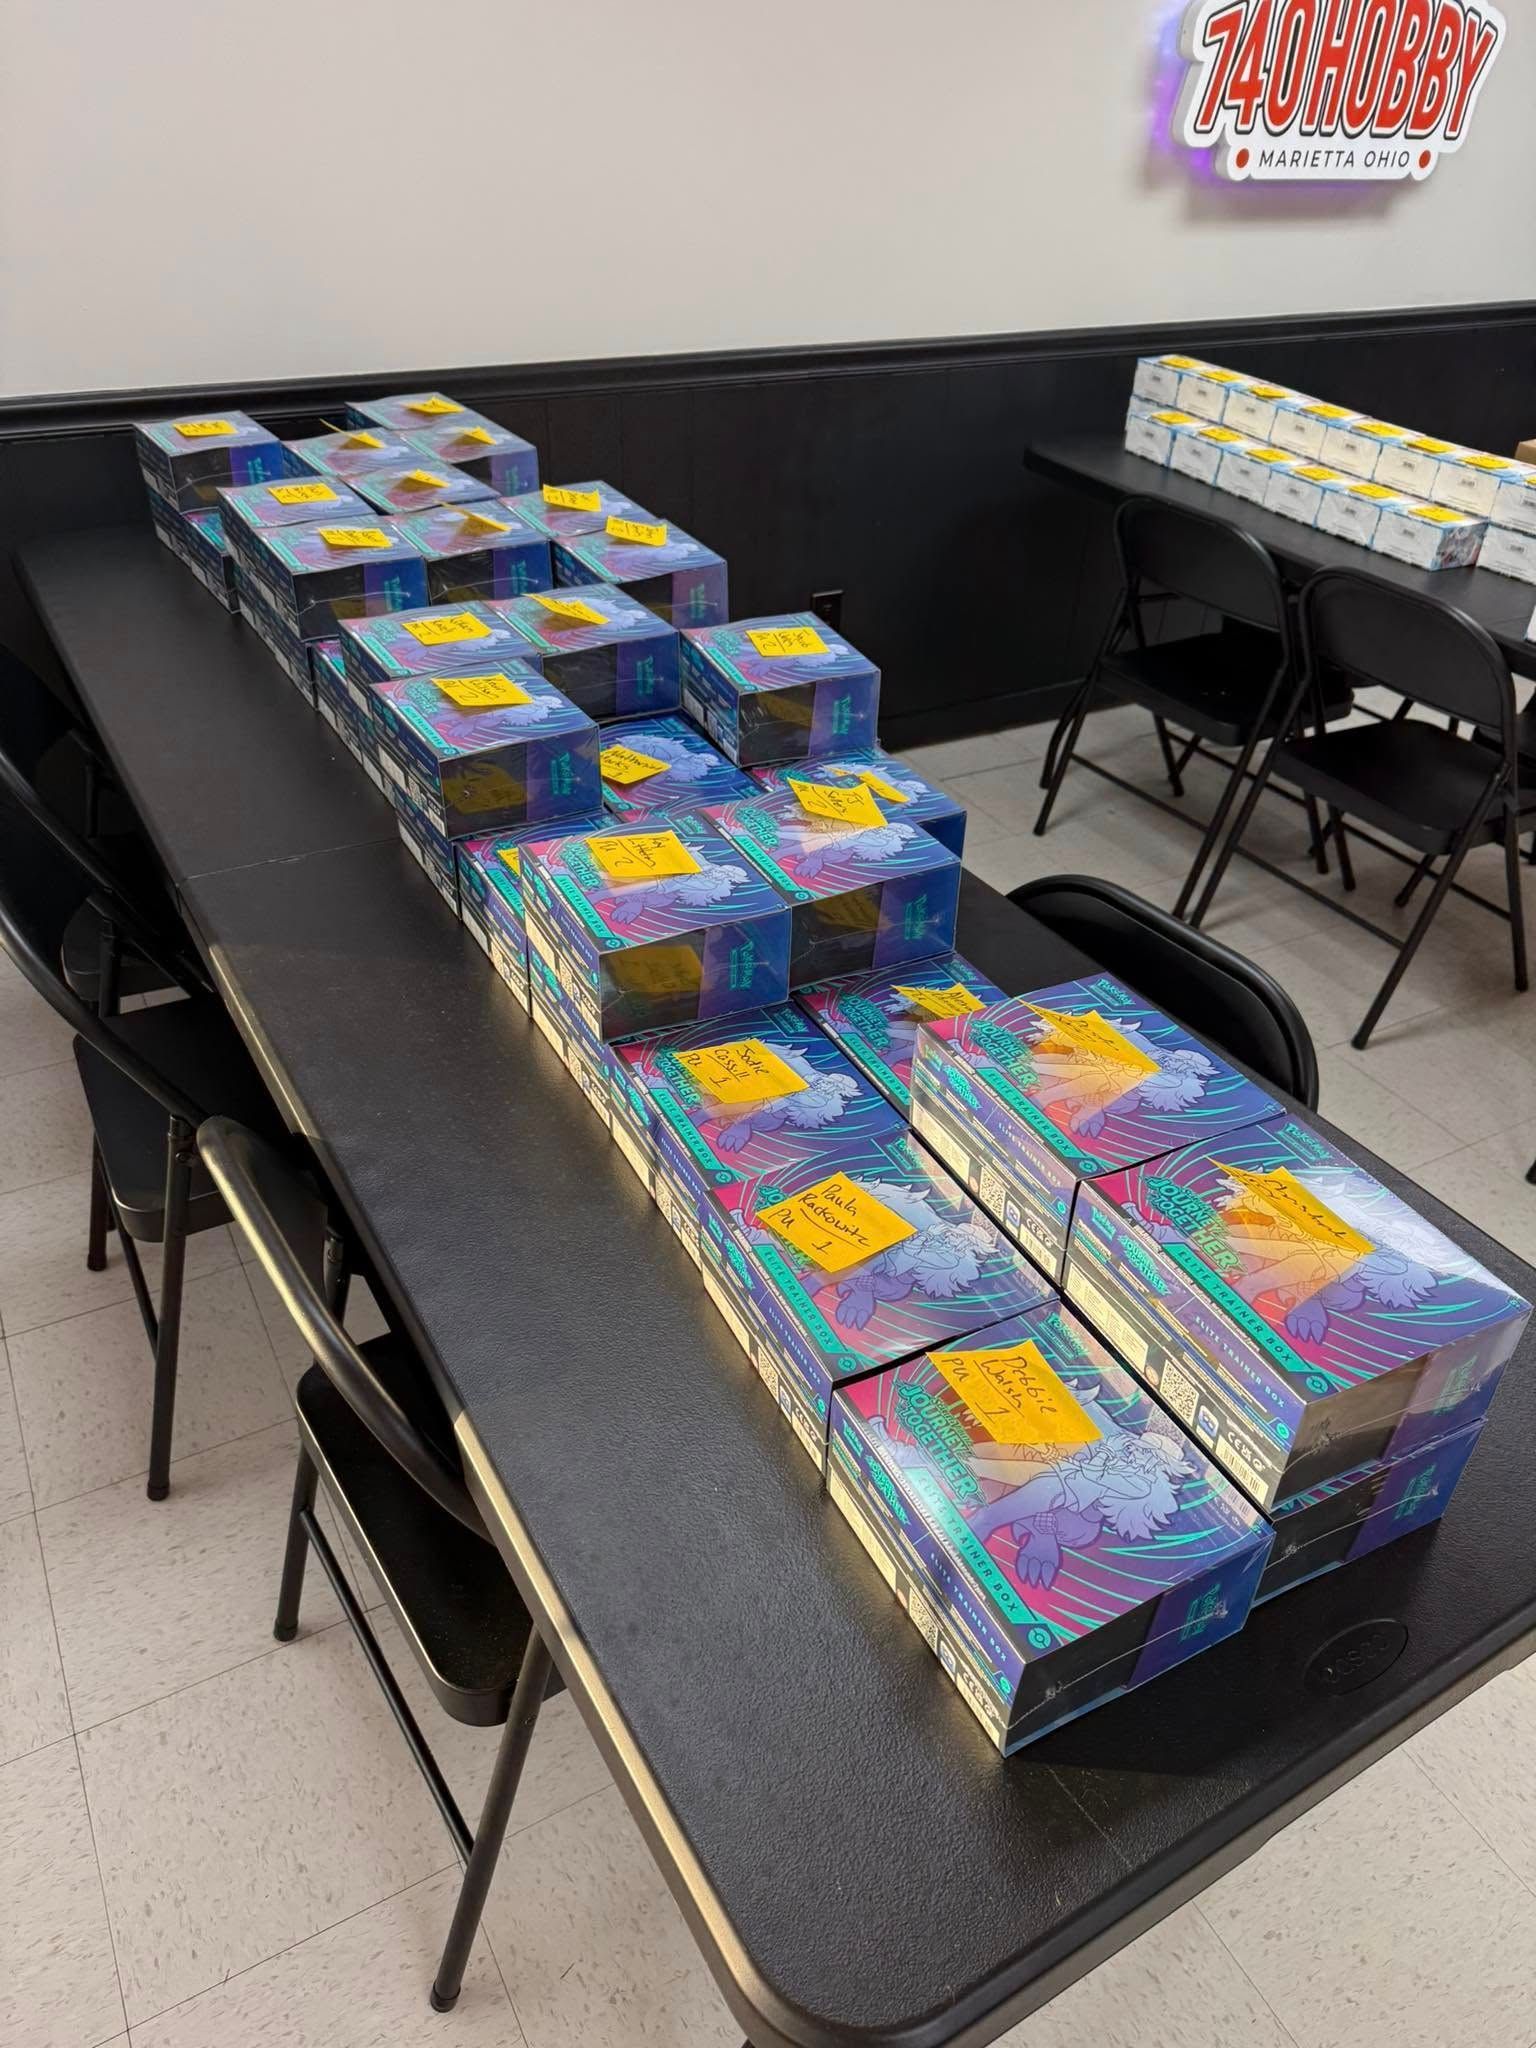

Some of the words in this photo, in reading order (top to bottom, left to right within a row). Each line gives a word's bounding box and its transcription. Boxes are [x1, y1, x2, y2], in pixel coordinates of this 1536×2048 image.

[1259, 149, 1355, 168] MARIETTA
[1364, 150, 1410, 168] OHIO
[977, 1032, 1037, 1087] TOGETHER
[1050, 1133, 1070, 1151] BOX
[821, 1183, 858, 1218] Paula
[1146, 1176, 1223, 1235] JOURNEY
[1153, 1194, 1239, 1270] TOGETHER
[815, 1323, 834, 1346] BOX
[1178, 1250, 1211, 1282] ELITE
[1213, 1282, 1263, 1334] TRAINER
[1265, 1337, 1293, 1362] BOX
[1223, 1342, 1262, 1385] TRAINER
[1265, 1386, 1286, 1408] BOX
[900, 1380, 966, 1459] JOURNEY
[902, 1406, 979, 1501] TOGETHER
[950, 1518, 993, 1580] TRAINER
[992, 1582, 1020, 1613] BOX
[989, 1636, 1008, 1663] BOX
